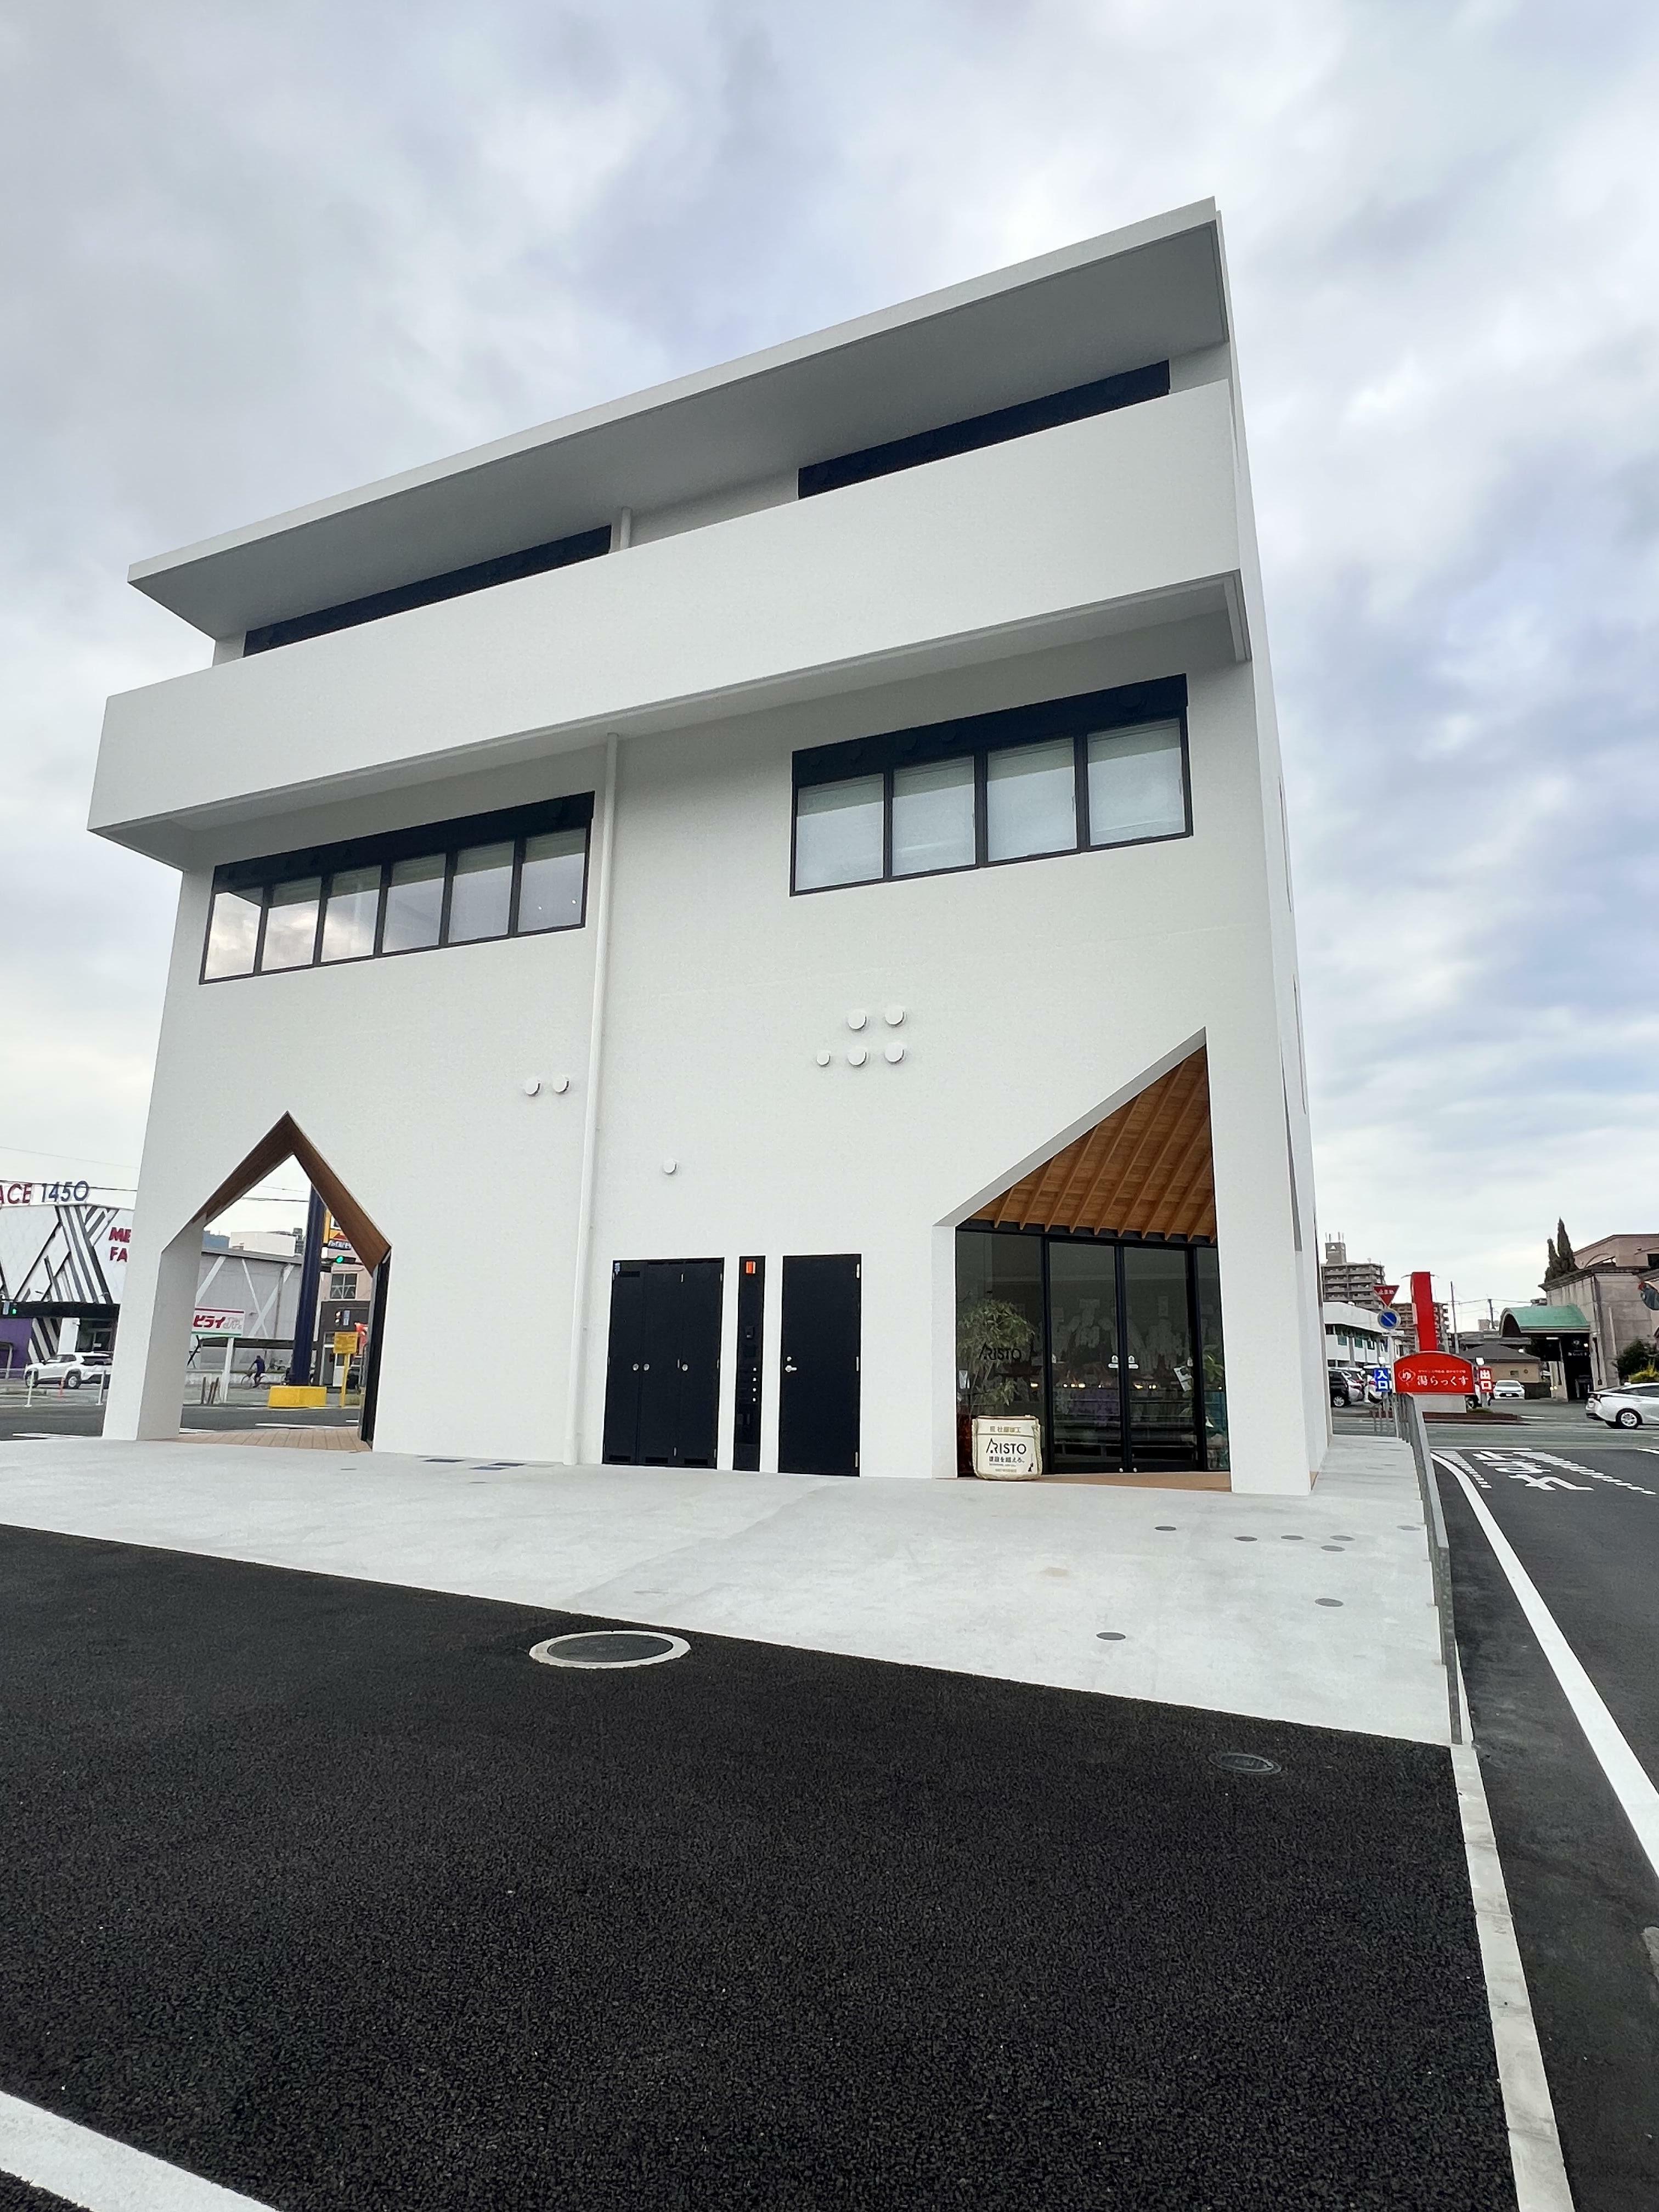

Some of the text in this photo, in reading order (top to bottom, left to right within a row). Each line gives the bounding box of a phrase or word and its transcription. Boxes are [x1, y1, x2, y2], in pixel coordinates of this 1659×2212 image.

[42, 1181, 89, 1203] 1450
[979, 1342, 1021, 1361] ARISTO
[1378, 1370, 1389, 1389] 入口
[1417, 1375, 1469, 1386] 湯らっくす
[1480, 1370, 1492, 1390] 出口
[986, 1437, 1026, 1454] ARISTO
[1472, 1451, 1594, 1491] 止まれ
